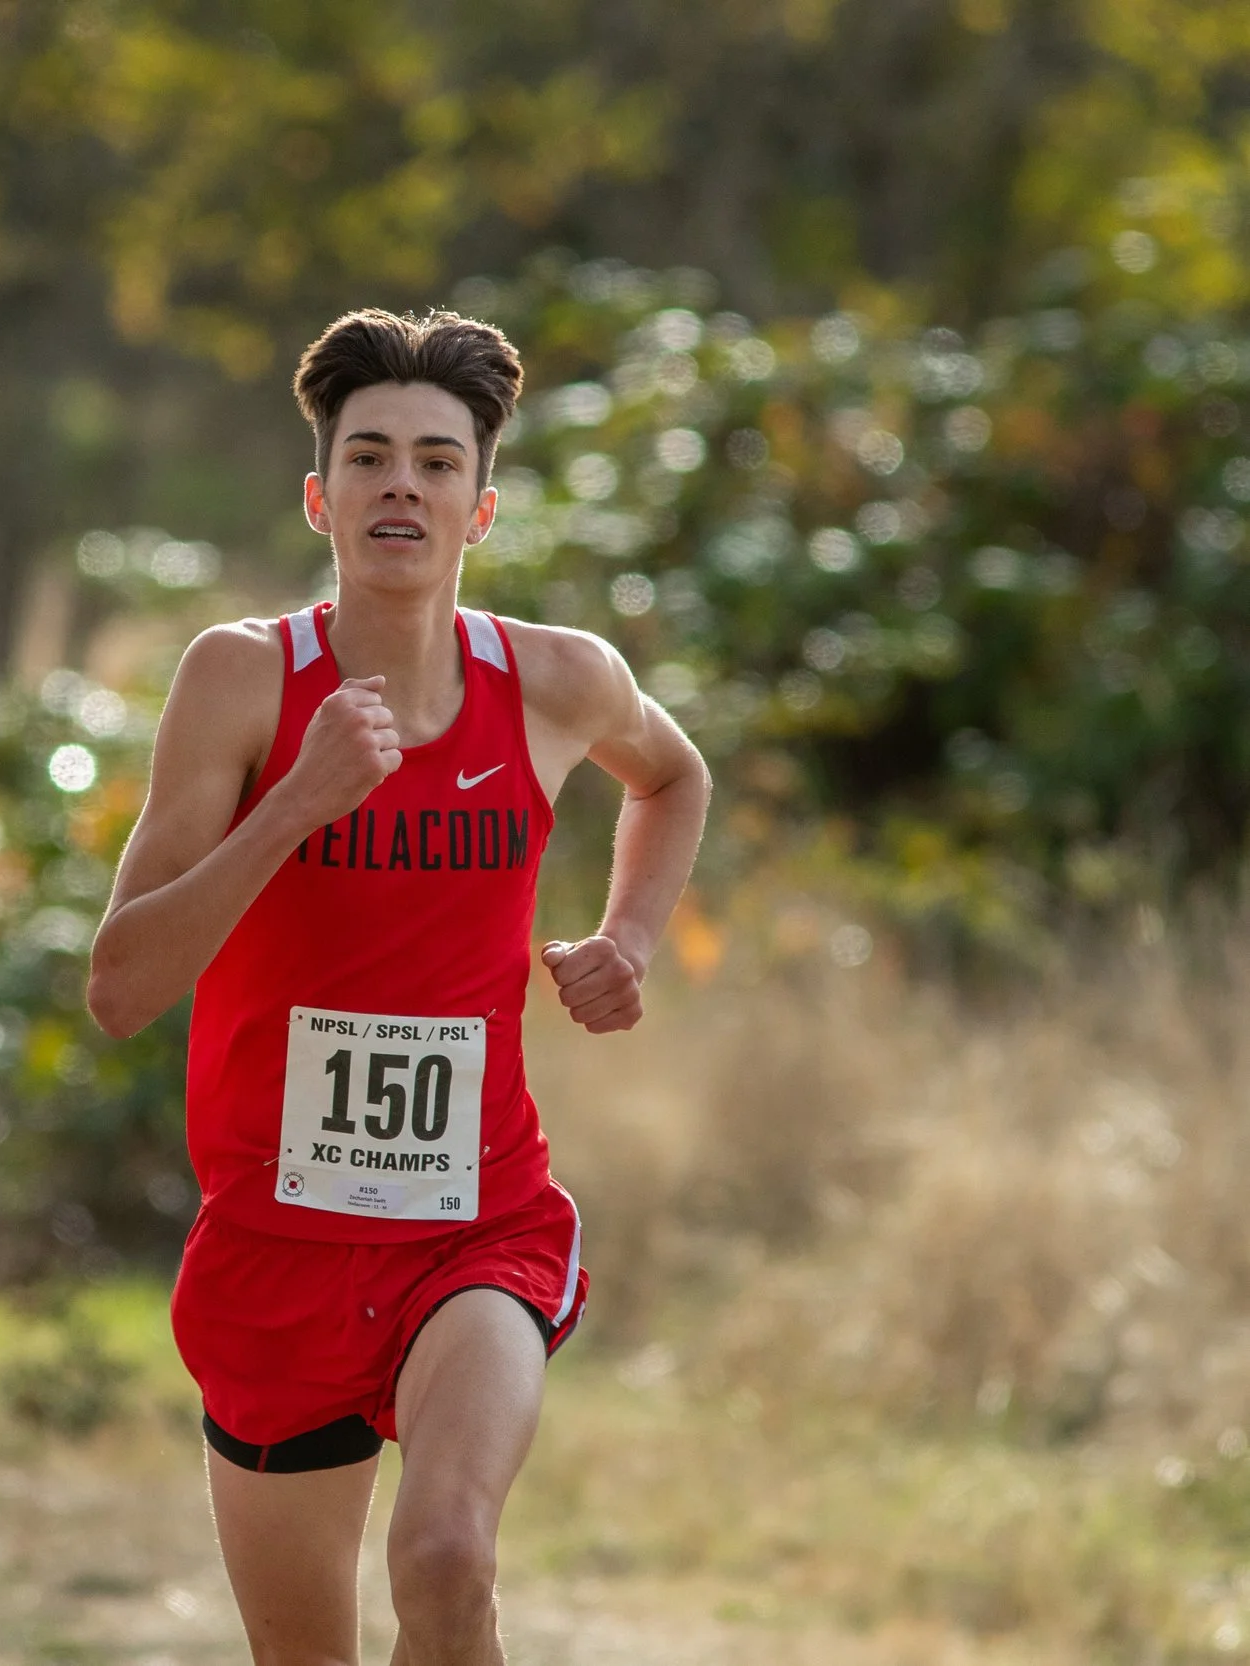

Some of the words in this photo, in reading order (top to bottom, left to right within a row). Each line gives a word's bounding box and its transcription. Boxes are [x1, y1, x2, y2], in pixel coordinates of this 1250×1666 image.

[310, 1017, 358, 1037] NPSL
[362, 1023, 372, 1039] /
[376, 1025, 422, 1041] SPSL
[426, 1026, 435, 1042] /
[439, 1027, 470, 1041] PSL
[321, 1049, 453, 1142] 150
[310, 1142, 342, 1164] XC
[350, 1148, 450, 1172] CHAMPS
[359, 1186, 378, 1195] #150
[440, 1196, 460, 1210] 150
